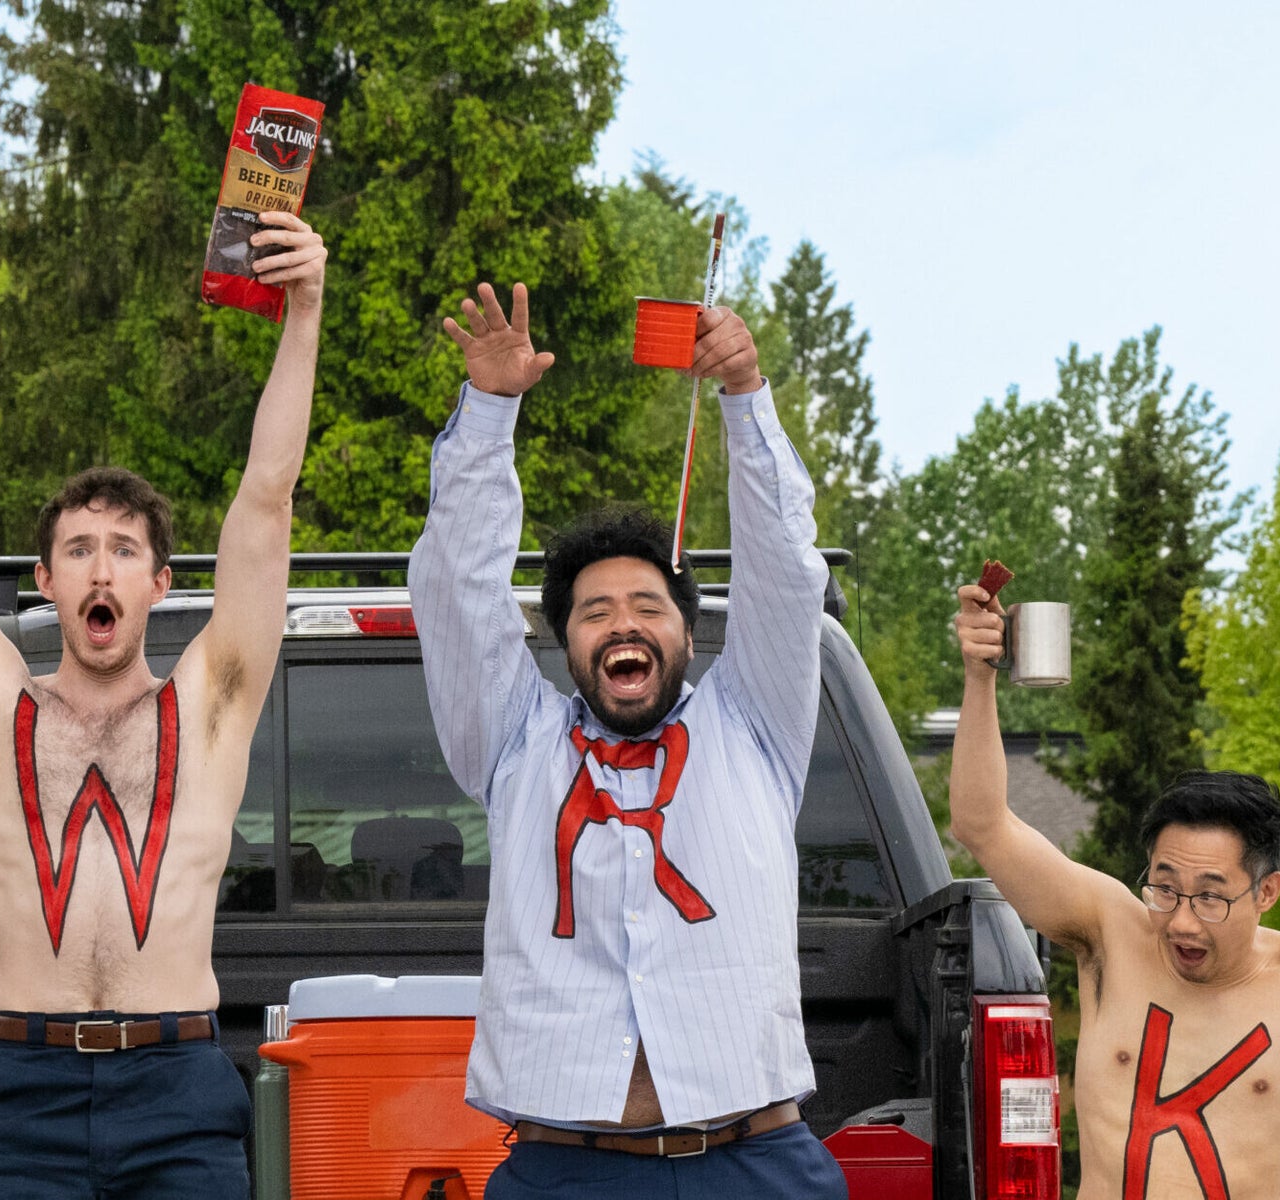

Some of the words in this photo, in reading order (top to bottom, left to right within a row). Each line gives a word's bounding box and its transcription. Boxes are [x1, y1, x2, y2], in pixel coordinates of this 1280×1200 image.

[238, 168, 271, 187] BEEF
[272, 177, 304, 196] JERKY
[245, 116, 286, 143] JACK
[246, 190, 294, 212] ORIGINAL
[14, 677, 180, 957] W
[552, 720, 716, 939] R
[1123, 1002, 1272, 1200] K
